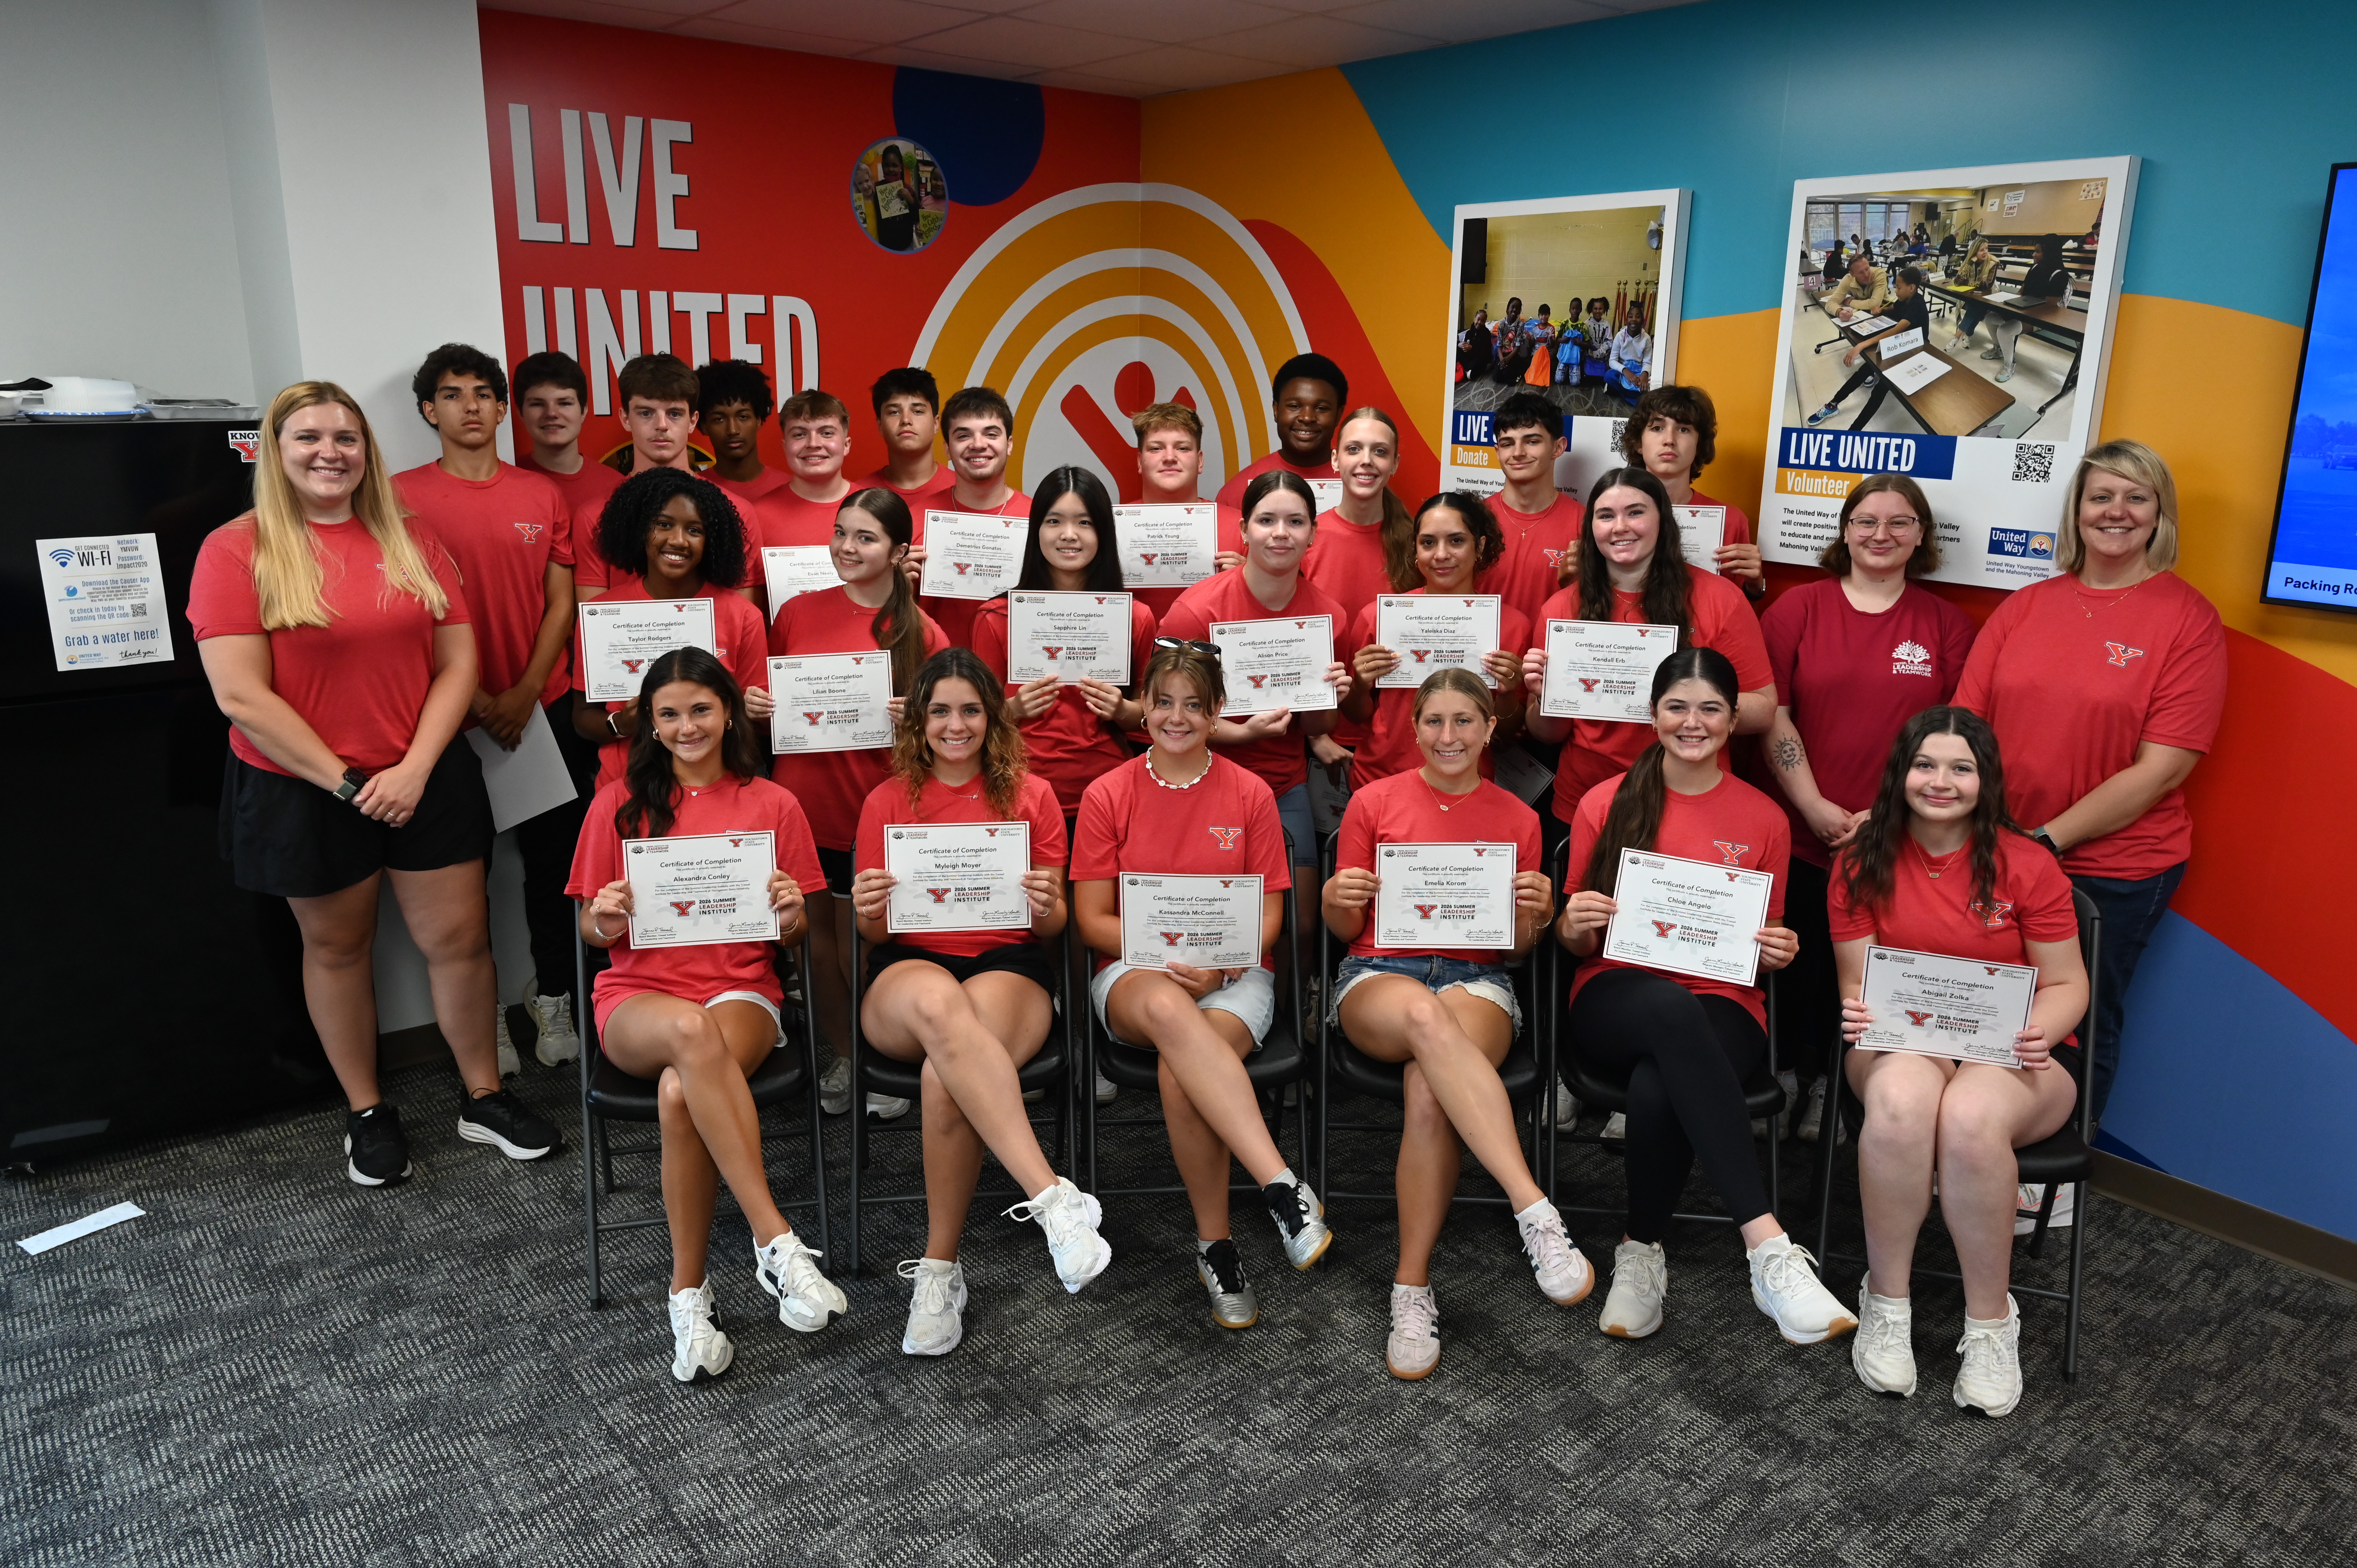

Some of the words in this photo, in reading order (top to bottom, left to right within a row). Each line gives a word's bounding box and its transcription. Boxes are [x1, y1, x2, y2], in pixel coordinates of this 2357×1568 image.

[508, 103, 698, 250] LIVE
[879, 187, 888, 195] How
[921, 214, 931, 222] How
[1809, 277, 1815, 286] 4
[1899, 337, 1918, 348] Komara
[1459, 415, 1489, 442] LIVE
[1457, 447, 1488, 466] Donate
[1789, 433, 1833, 466] LIVE
[1838, 436, 1916, 471] UNITED
[1787, 471, 1850, 496] Volunteer
[514, 522, 543, 544] Y
[1939, 523, 1959, 531] Valley
[1992, 530, 2026, 542] United
[1779, 542, 1808, 552] Mahoning
[2004, 542, 2025, 555] Way
[78, 551, 111, 567] WI-FI
[82, 578, 108, 587] Download
[2285, 577, 2340, 595] Packing
[65, 635, 89, 646] Grab
[93, 636, 98, 645] a
[102, 632, 130, 644] water
[134, 629, 159, 641] here!
[119, 649, 142, 659] thank
[143, 648, 157, 658] you!
[2104, 640, 2145, 668] Y
[1209, 826, 1242, 850] Y
[1713, 839, 1749, 866] Y
[705, 858, 741, 866] Completion
[1652, 878, 1685, 889] Certificate
[1696, 886, 1733, 898] Completion
[1688, 901, 1711, 910] Angelo
[1922, 989, 1947, 998] Abigail
[1949, 993, 1969, 1001] Zolka
